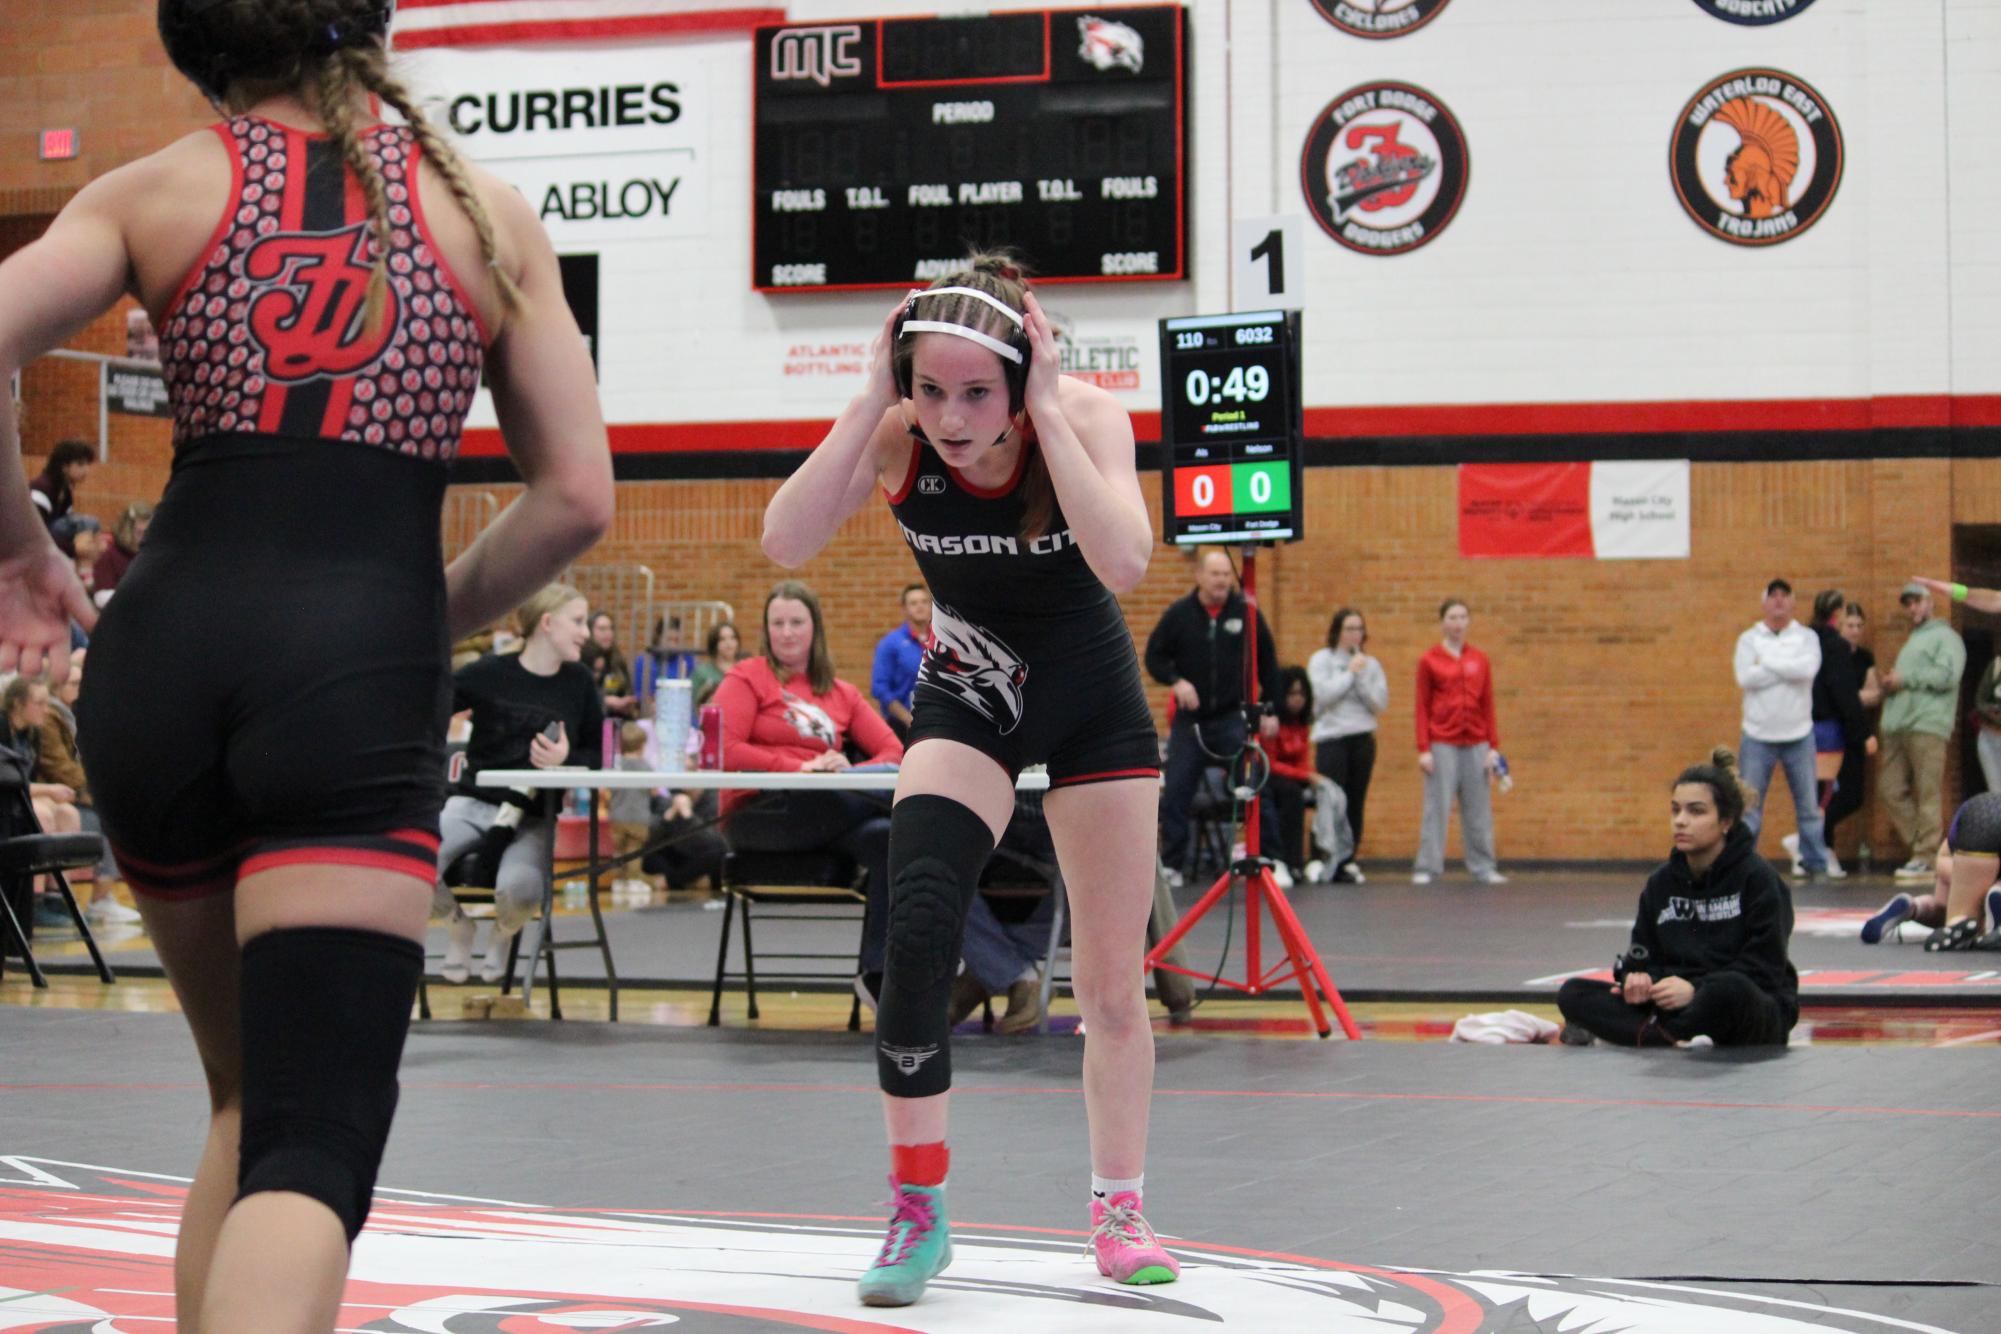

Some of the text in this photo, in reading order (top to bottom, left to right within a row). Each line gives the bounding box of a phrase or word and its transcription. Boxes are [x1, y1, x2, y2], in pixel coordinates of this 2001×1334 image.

[1333, 4, 1421, 32] CYCLONES
[449, 81, 682, 136] CURRIES
[931, 101, 995, 124] PERIOD
[1332, 88, 1440, 127] FORT DODGE
[1689, 75, 1824, 127] WATERLOO EAST
[540, 176, 682, 221] ABLOY
[772, 188, 827, 212] FOULS
[908, 183, 953, 207] FOUL
[958, 181, 1023, 205] PLAYER
[1101, 175, 1158, 199] FOULS
[1343, 220, 1425, 249] DODGERS
[1717, 210, 1799, 238] TROJANS
[771, 251, 1159, 286] SCORE ADVAN SCORE
[1250, 228, 1285, 295] 1
[788, 343, 866, 357] ATLANTIC
[1176, 331, 1204, 350] 110
[1235, 326, 1274, 345] 6032
[783, 361, 863, 376] BOTTLING
[1059, 346, 1139, 371] HLETIC
[1185, 364, 1270, 407] 0:49
[1192, 474, 1215, 508] 0
[1249, 470, 1272, 505] 0
[898, 519, 1078, 556] MASON CIT
